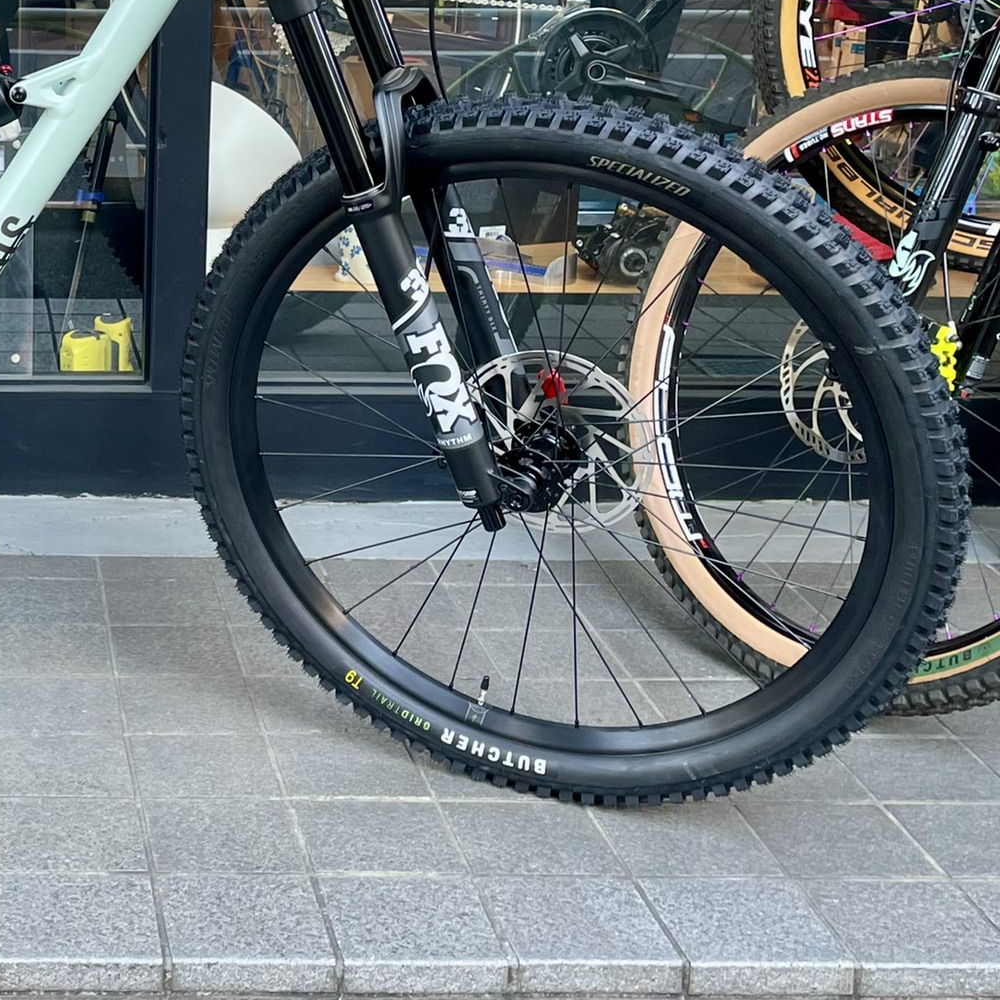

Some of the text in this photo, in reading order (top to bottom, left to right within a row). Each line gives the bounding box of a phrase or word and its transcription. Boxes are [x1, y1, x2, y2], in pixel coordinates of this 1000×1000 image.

[586, 155, 692, 197] SPECIALIZED
[405, 320, 478, 434] FOX
[344, 669, 364, 690] T9
[915, 653, 973, 675] BUTC
[439, 727, 548, 776] BUTCHER
